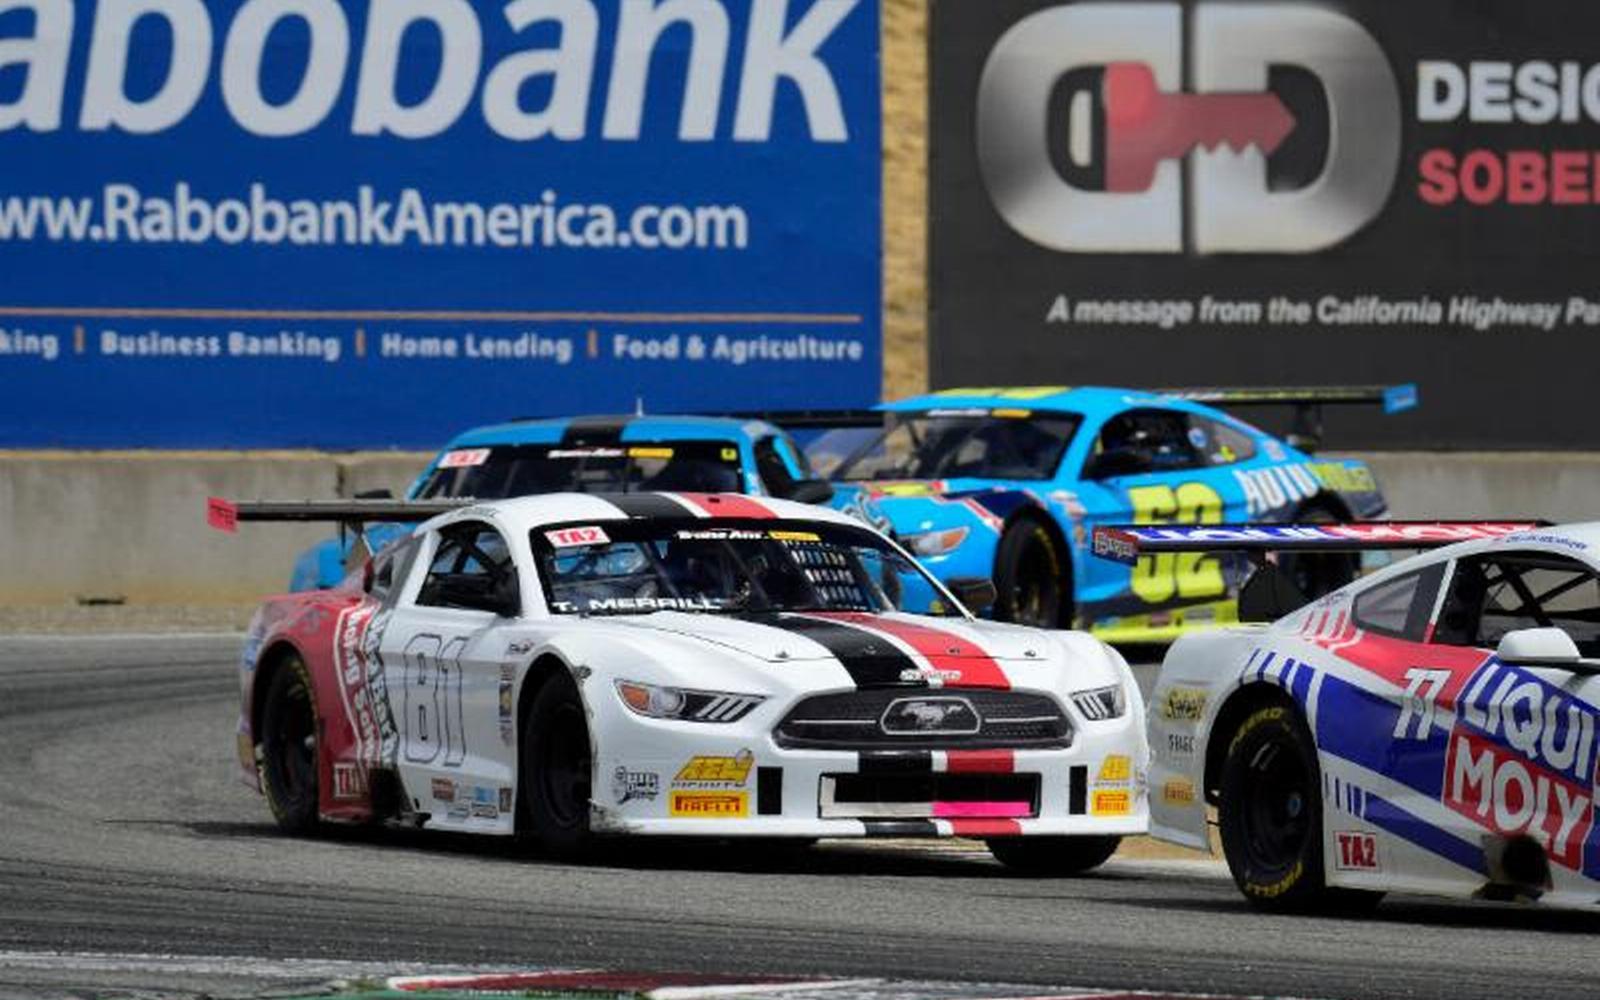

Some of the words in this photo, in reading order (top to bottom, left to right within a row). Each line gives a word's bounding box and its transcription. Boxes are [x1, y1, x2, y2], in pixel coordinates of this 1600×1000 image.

[1418, 147, 1600, 206] SOBE
[1046, 295, 1069, 323] A
[1074, 299, 1194, 329] message
[1200, 295, 1262, 323] from
[1268, 296, 1311, 323] the
[1317, 295, 1443, 324] California
[1449, 296, 1562, 330] Highway
[101, 330, 221, 356] Business
[228, 331, 341, 362] Banking
[381, 333, 457, 358] Home
[465, 334, 573, 363] Lending
[613, 335, 680, 359] Food
[687, 337, 706, 360] &
[712, 335, 863, 365] Agriculture
[1232, 463, 1320, 513] AUTO
[556, 528, 599, 544] TA2
[1129, 482, 1225, 603] 52
[589, 597, 723, 611] MERRILL
[402, 632, 467, 768] 81
[1392, 667, 1452, 740] 77
[1463, 662, 1594, 781] LIQUI
[1452, 735, 1591, 858] MOLY
[1338, 834, 1377, 868] TA2
